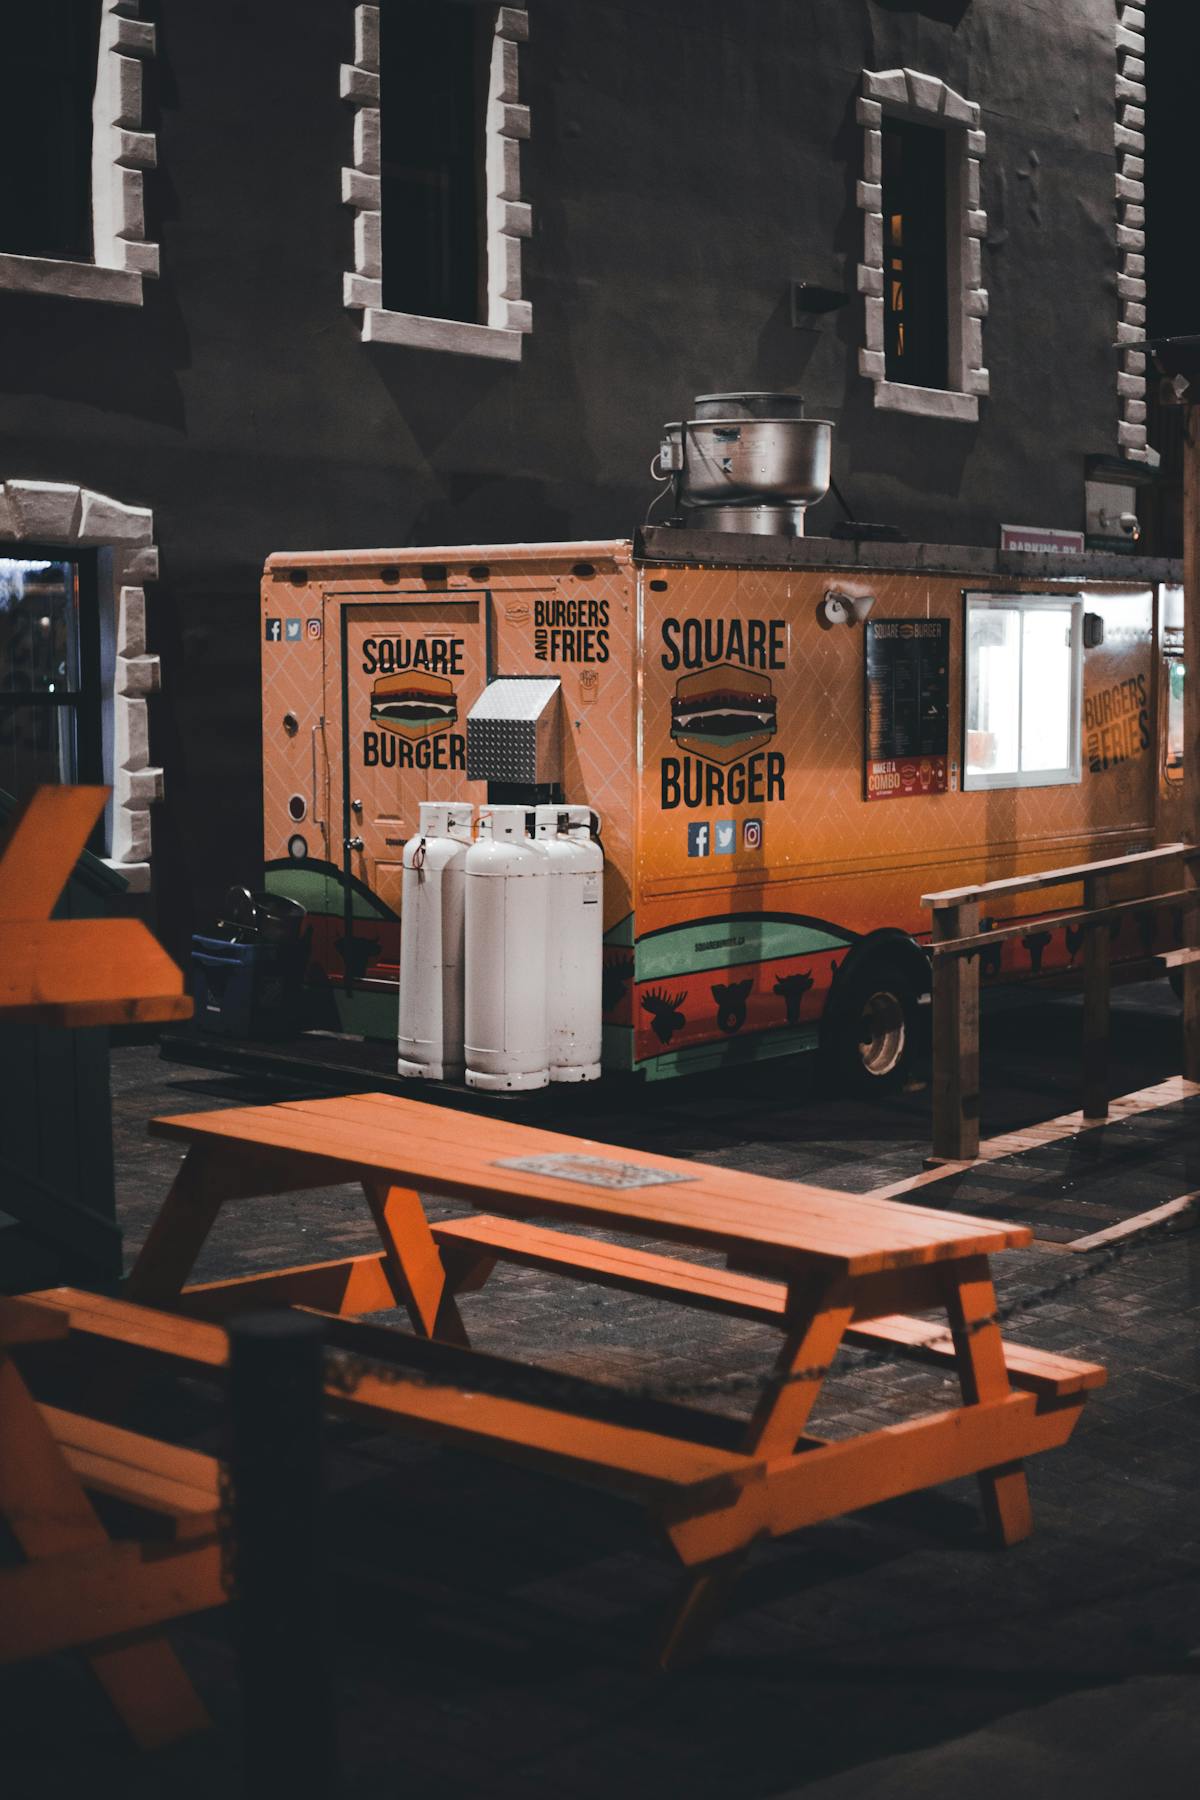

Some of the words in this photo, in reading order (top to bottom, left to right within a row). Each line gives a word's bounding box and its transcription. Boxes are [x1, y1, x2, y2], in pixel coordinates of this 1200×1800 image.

[534, 600, 610, 627] BURGERS
[873, 623, 899, 639] SQUARE
[914, 623, 942, 639] BURGER
[362, 639, 465, 675] SQUARE
[534, 629, 548, 660] AND
[550, 629, 610, 663] FRIES
[661, 617, 786, 671] SQUARE
[1085, 673, 1146, 732] BURGERS
[363, 732, 466, 770] BURGER
[1101, 709, 1150, 770] FRIES
[661, 752, 786, 810] BURGER
[868, 773, 900, 791] COMBO
